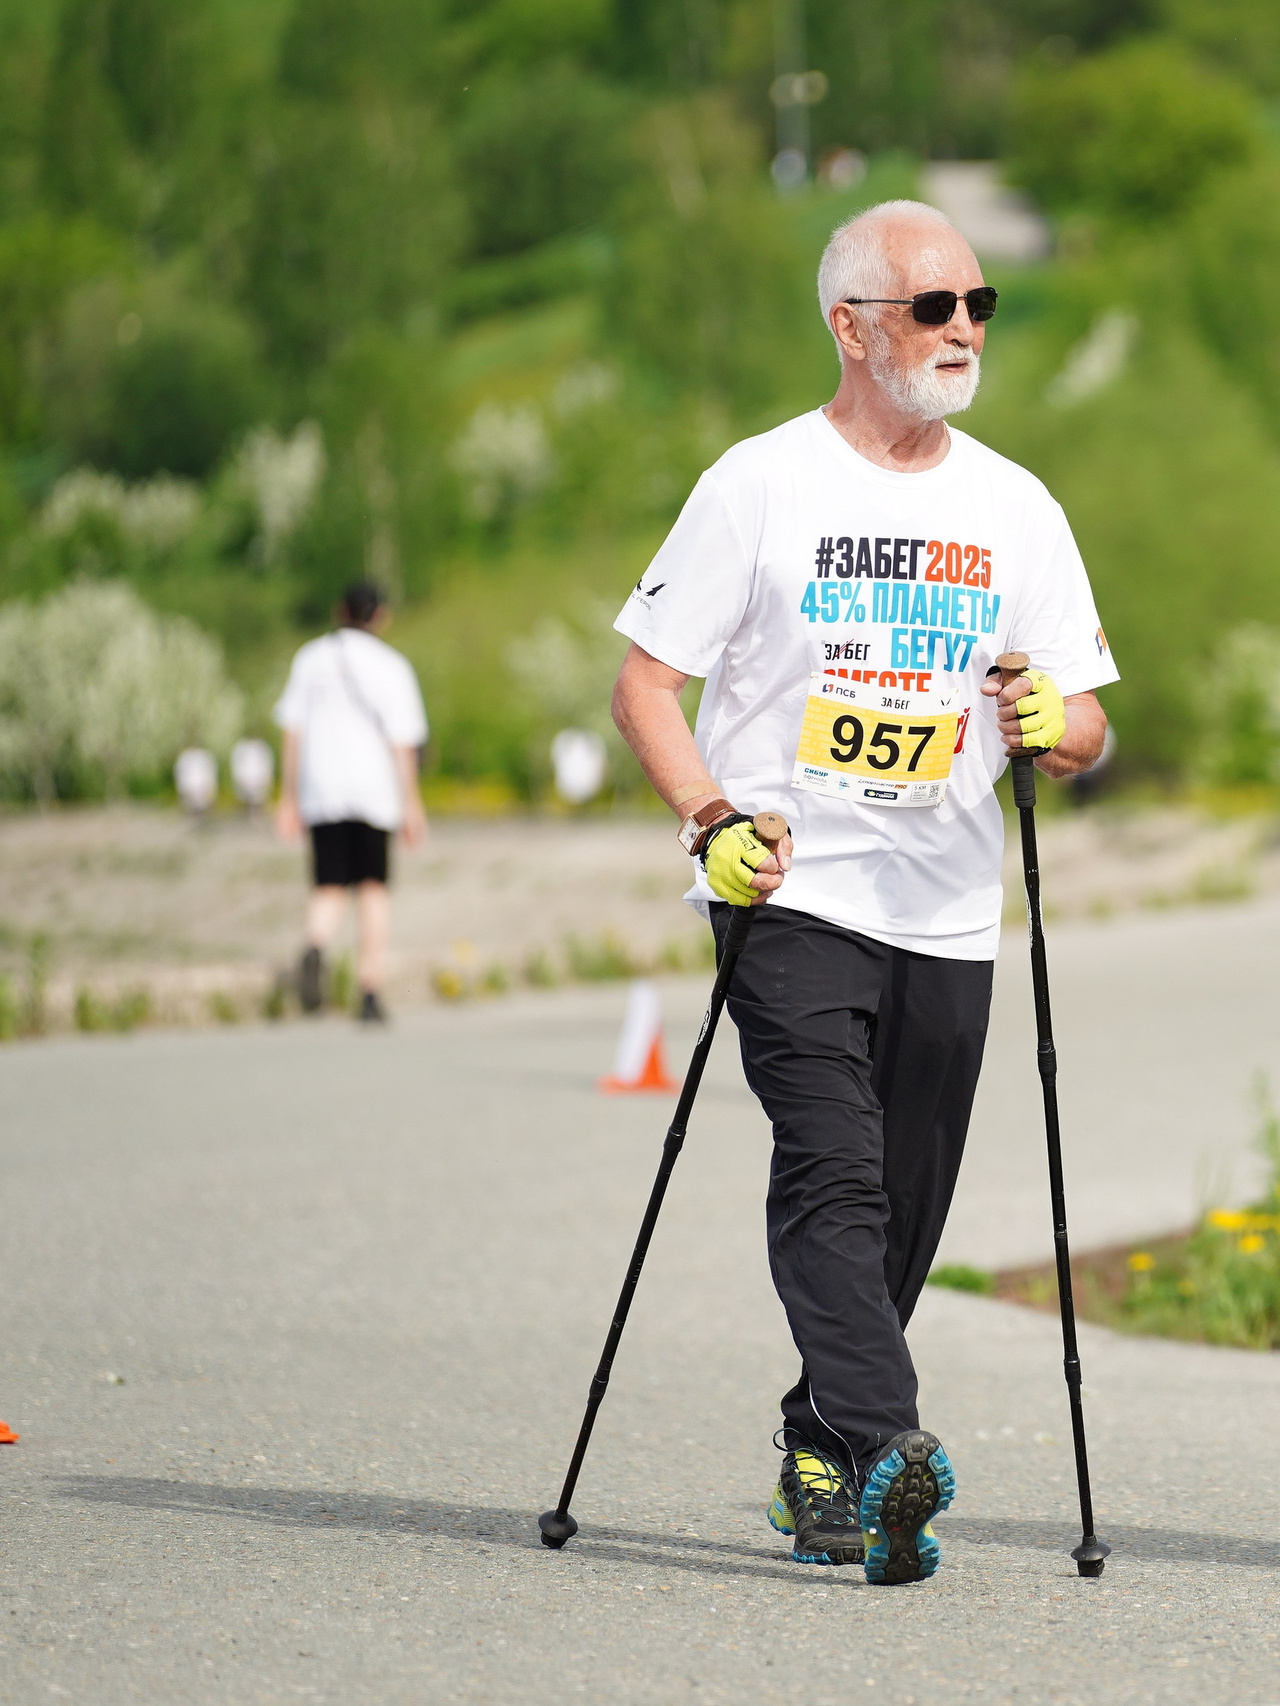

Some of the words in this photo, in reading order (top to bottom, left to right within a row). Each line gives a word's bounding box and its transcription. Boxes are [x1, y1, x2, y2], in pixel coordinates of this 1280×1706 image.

[815, 537, 991, 589] #ЗАБЕГ2025
[800, 581, 866, 623] 45%
[872, 582, 1001, 634] ПЛАНЕТЫ
[891, 628, 978, 673] БЕГУТ
[835, 686, 856, 699] ПСБ
[830, 714, 936, 772] 957
